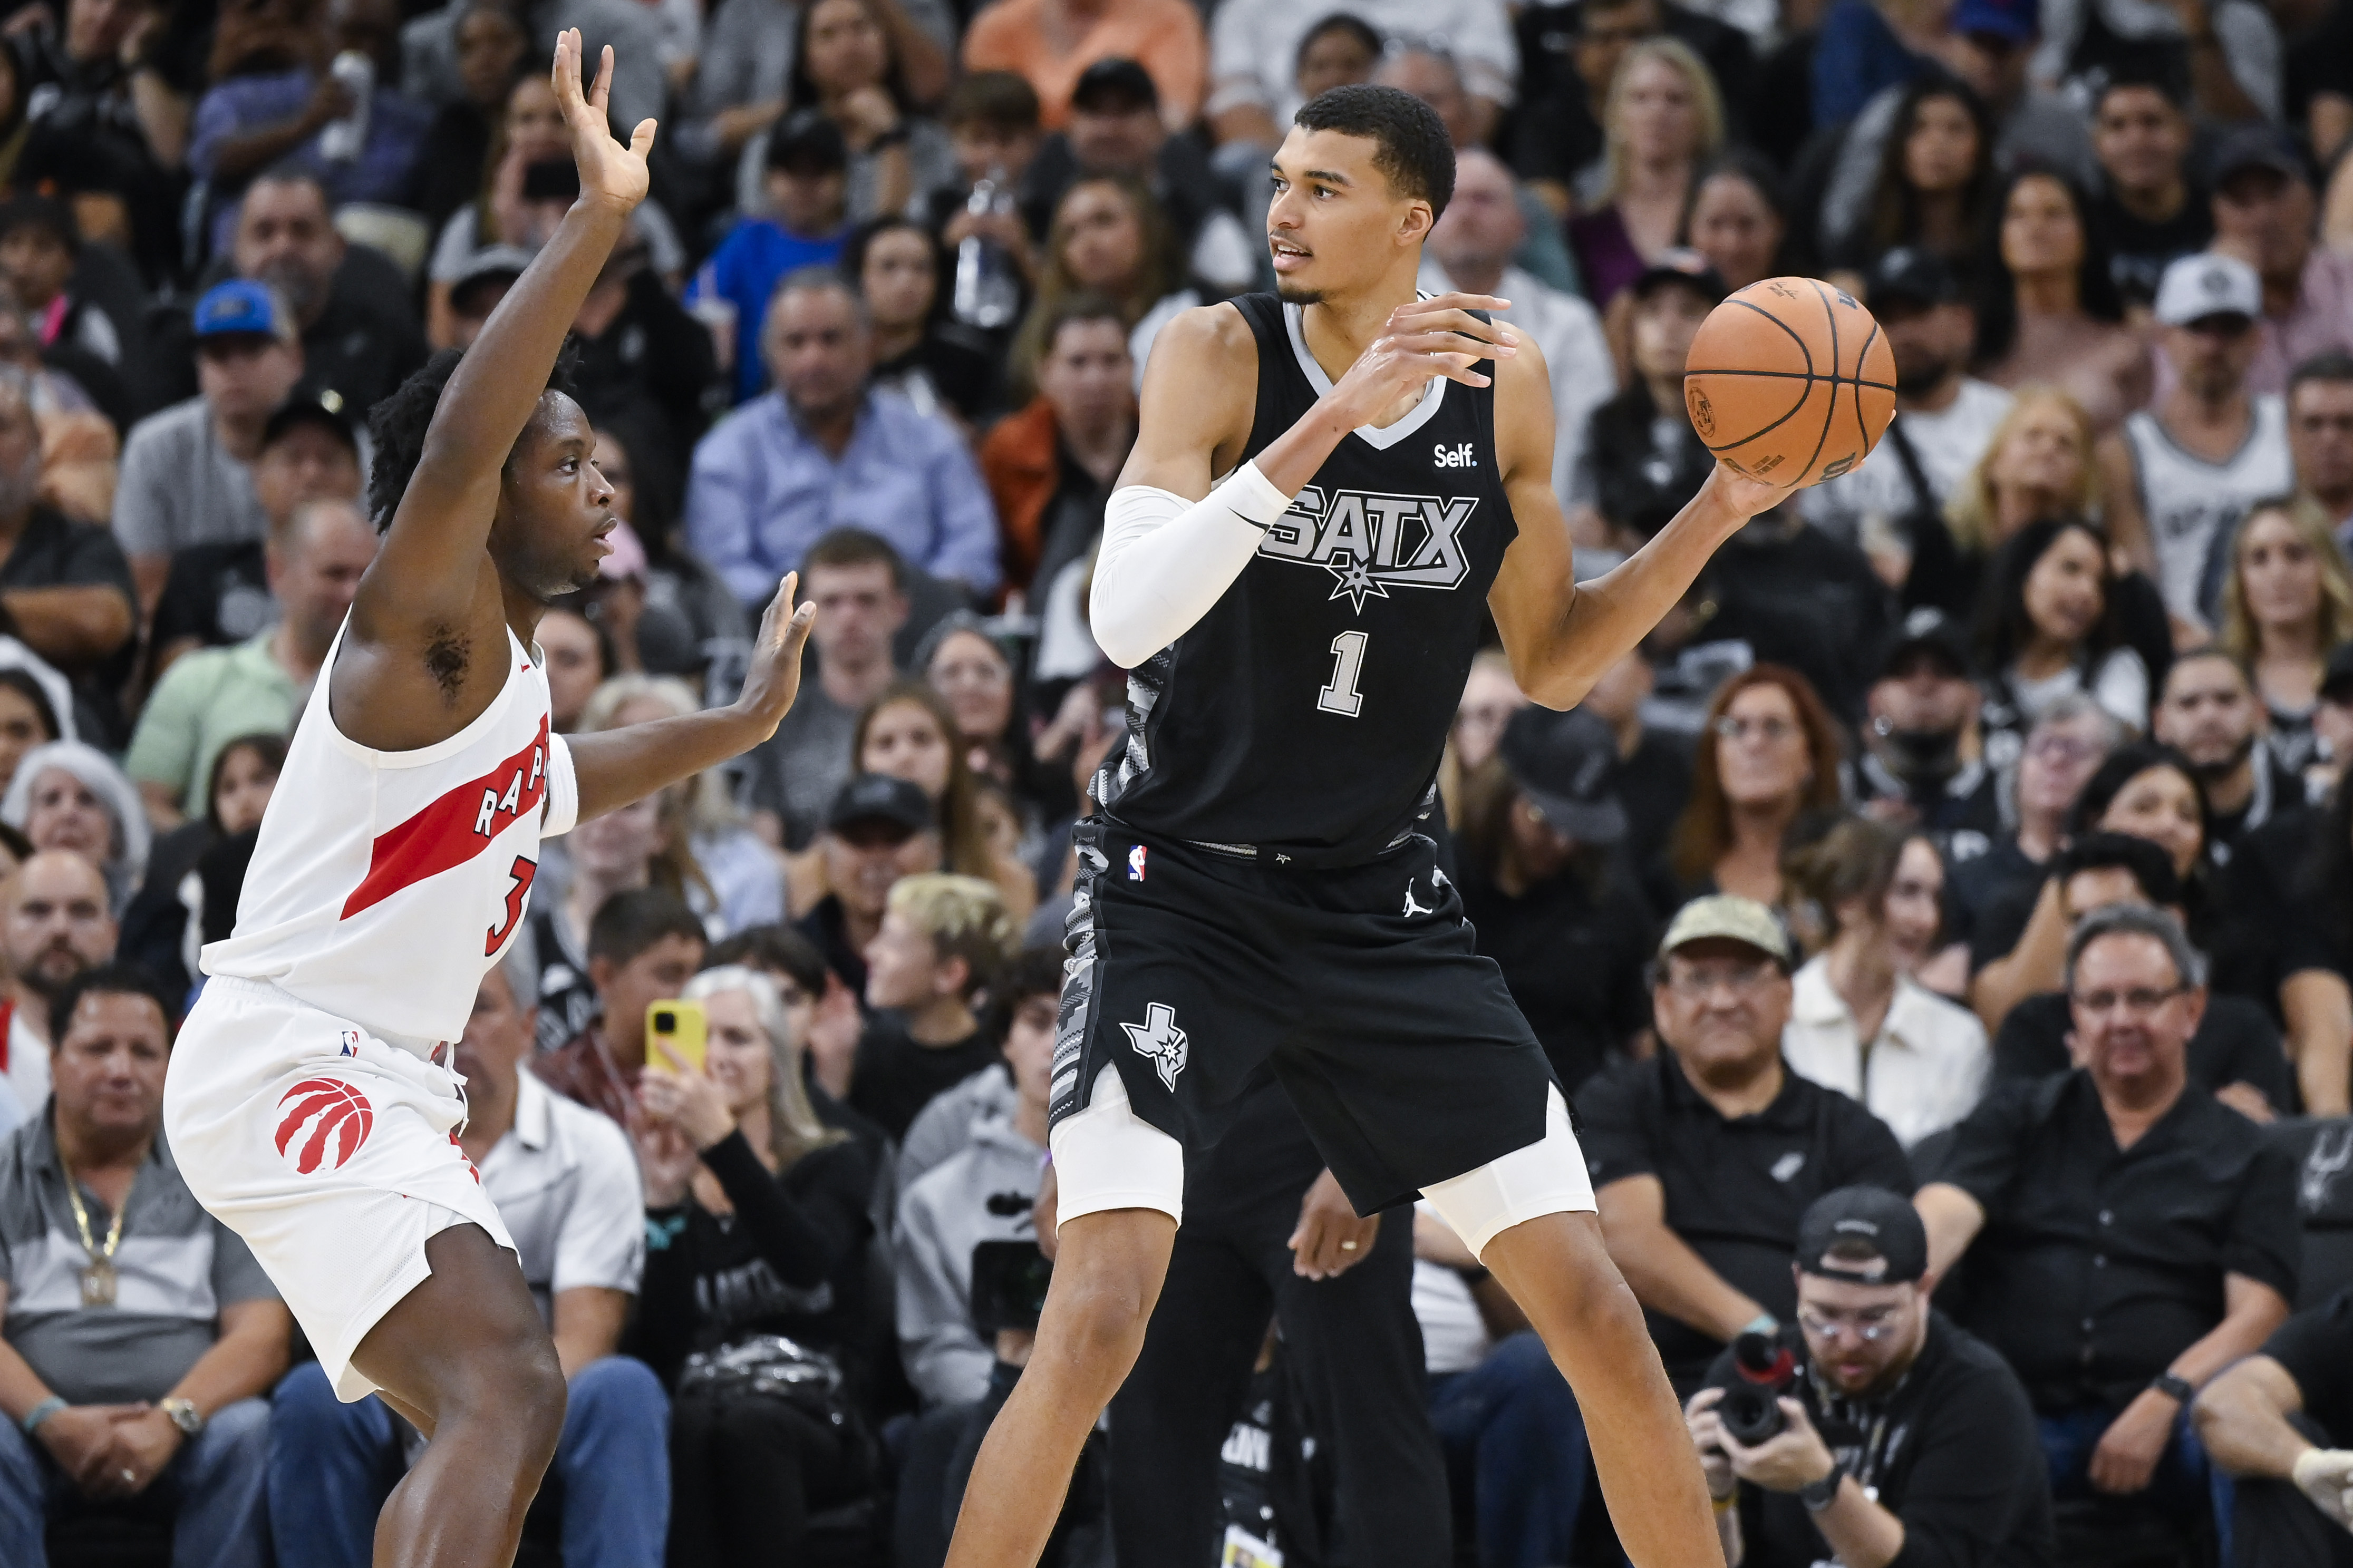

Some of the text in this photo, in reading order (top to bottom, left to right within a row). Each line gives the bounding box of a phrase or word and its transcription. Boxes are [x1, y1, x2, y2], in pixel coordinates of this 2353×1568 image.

[1434, 443, 1477, 468] Self.
[1256, 484, 1480, 591] SATX
[1316, 630, 1370, 718] 1
[485, 854, 538, 957] 3
